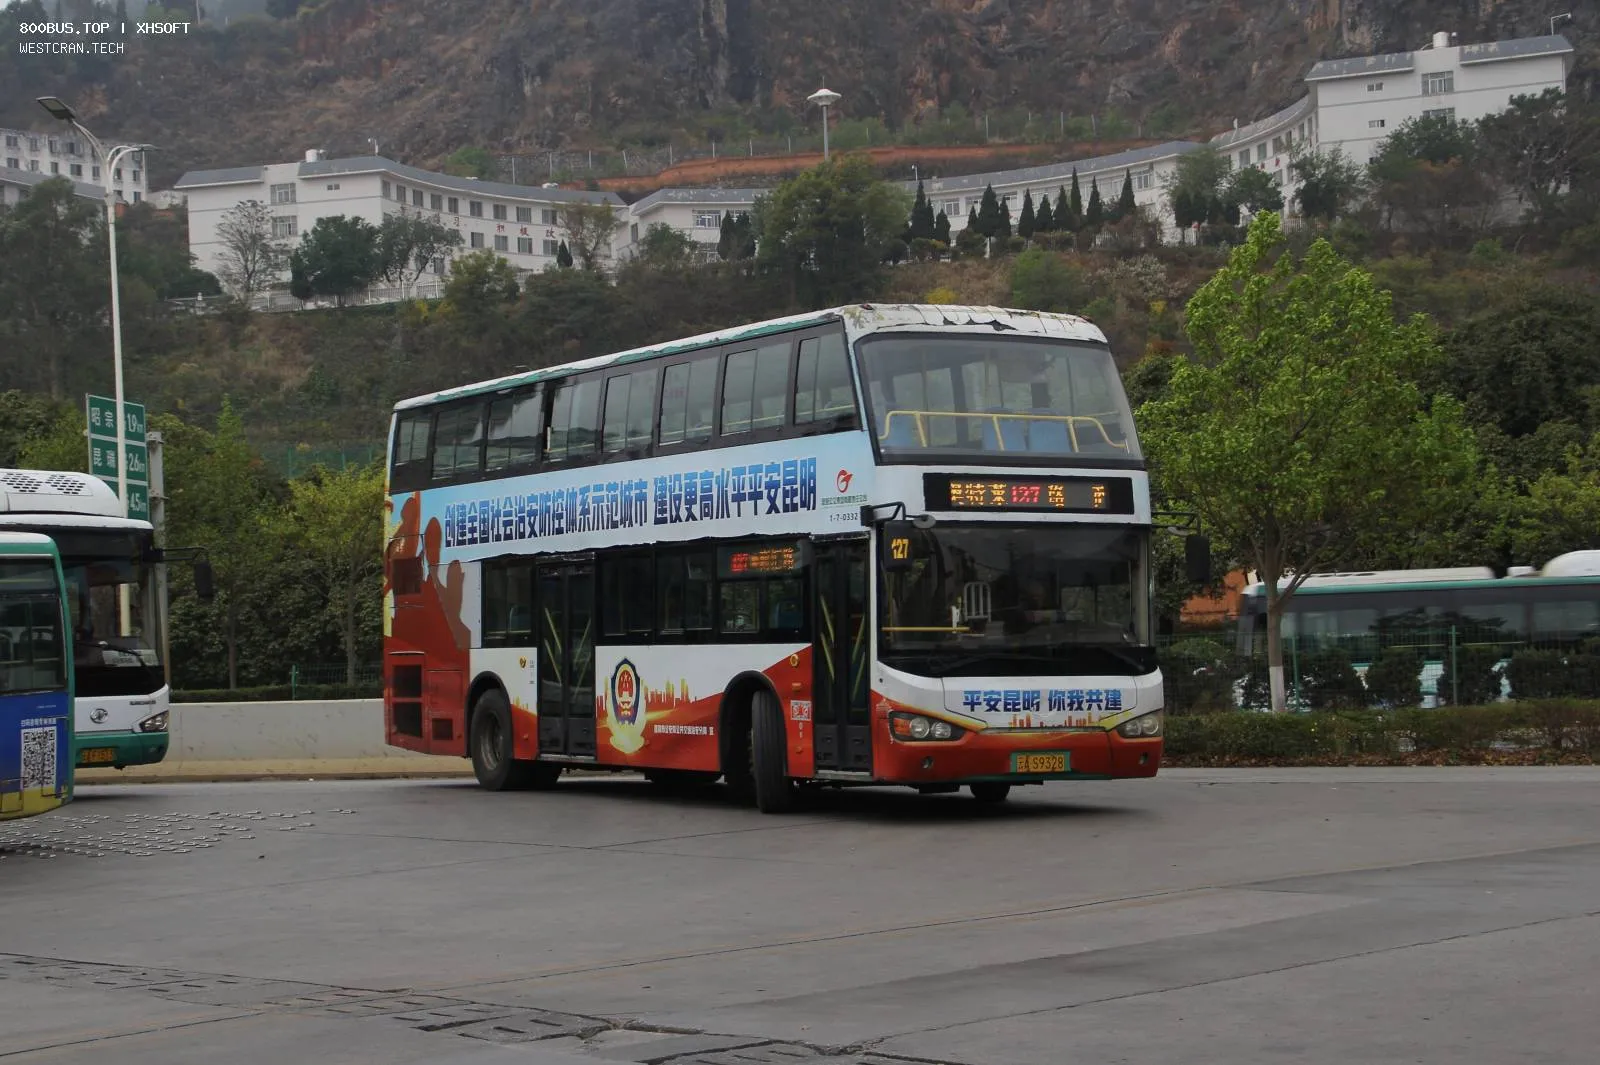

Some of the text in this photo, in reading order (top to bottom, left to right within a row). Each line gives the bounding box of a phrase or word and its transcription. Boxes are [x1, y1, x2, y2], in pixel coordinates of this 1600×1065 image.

[444, 457, 817, 548] 创建全国社会治安防控体系示范城市 建设更高水平平安昆明
[891, 538, 909, 559] 127
[963, 689, 1122, 712] 平安昆明 你我共建
